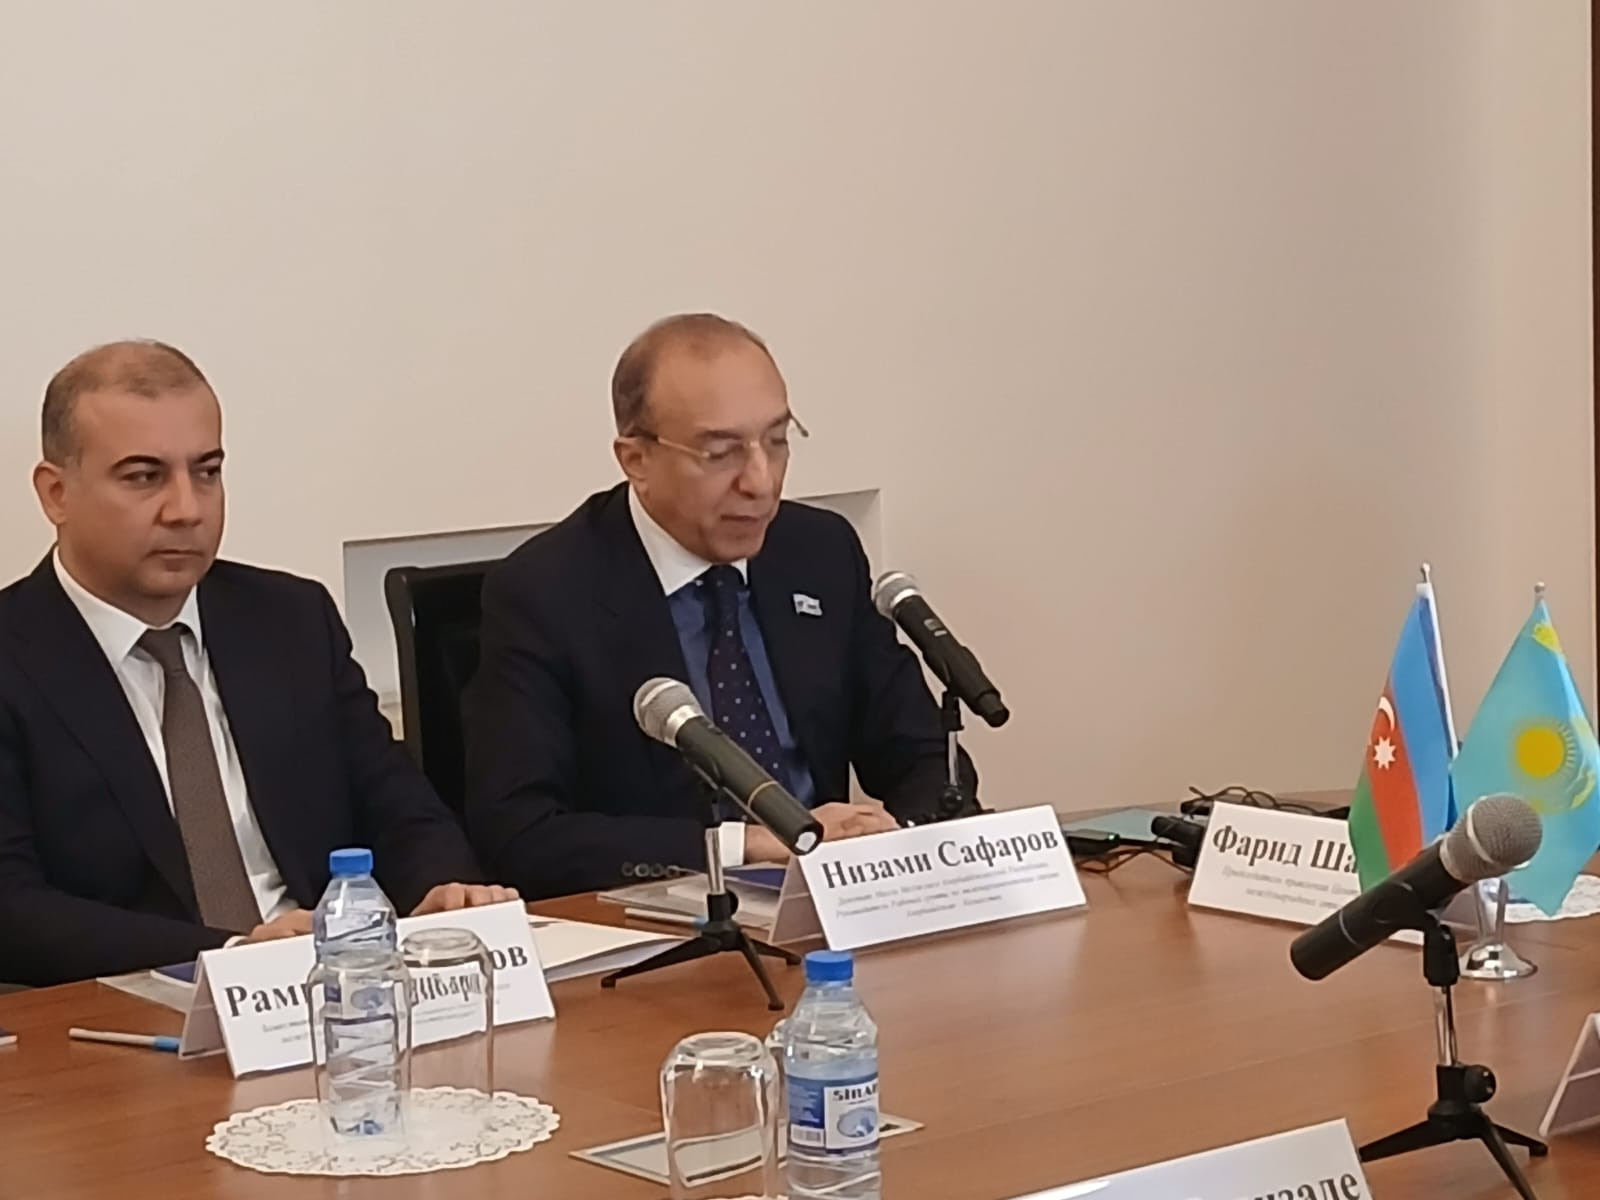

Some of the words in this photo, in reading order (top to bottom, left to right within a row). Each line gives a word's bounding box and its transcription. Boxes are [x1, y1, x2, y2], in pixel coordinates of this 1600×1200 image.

[821, 851, 932, 889] Низами
[938, 831, 1059, 868] Сафаров
[1212, 825, 1302, 867] Фарид
[1310, 839, 1358, 874] Ша
[224, 983, 308, 1017] Рам
